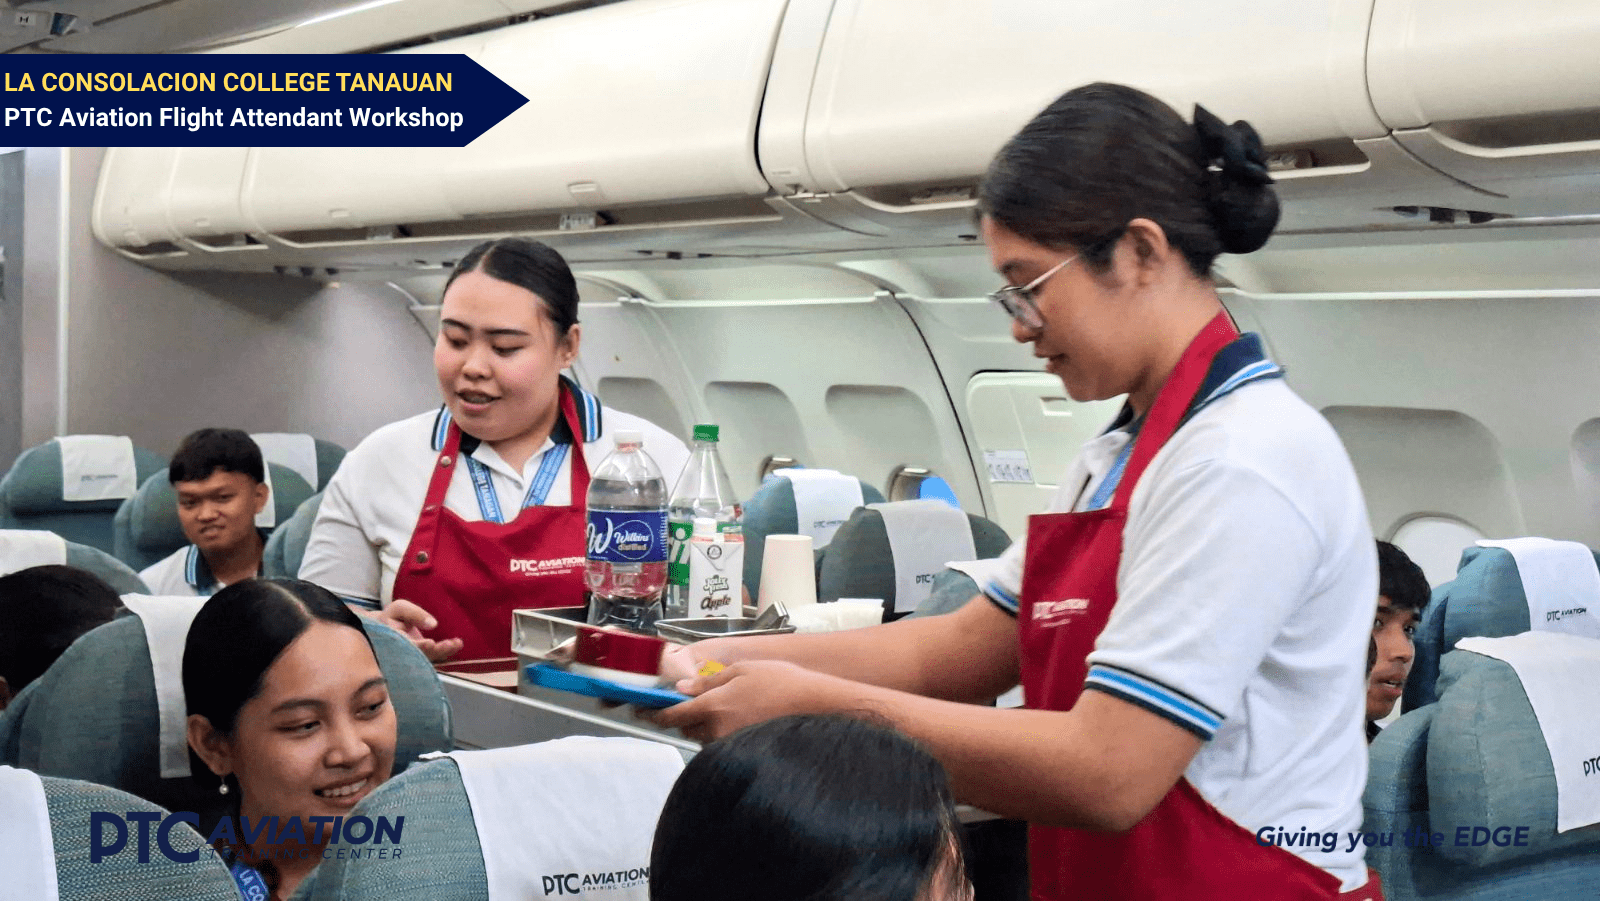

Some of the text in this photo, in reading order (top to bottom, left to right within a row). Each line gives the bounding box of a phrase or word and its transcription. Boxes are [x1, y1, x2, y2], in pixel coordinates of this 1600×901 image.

[614, 530, 650, 544] Wilkins
[510, 559, 538, 572] PTC
[538, 556, 586, 567] AVIATION
[700, 594, 732, 610] Apple
[1547, 610, 1561, 621] PTC
[541, 867, 650, 896] PTC AVIATION
